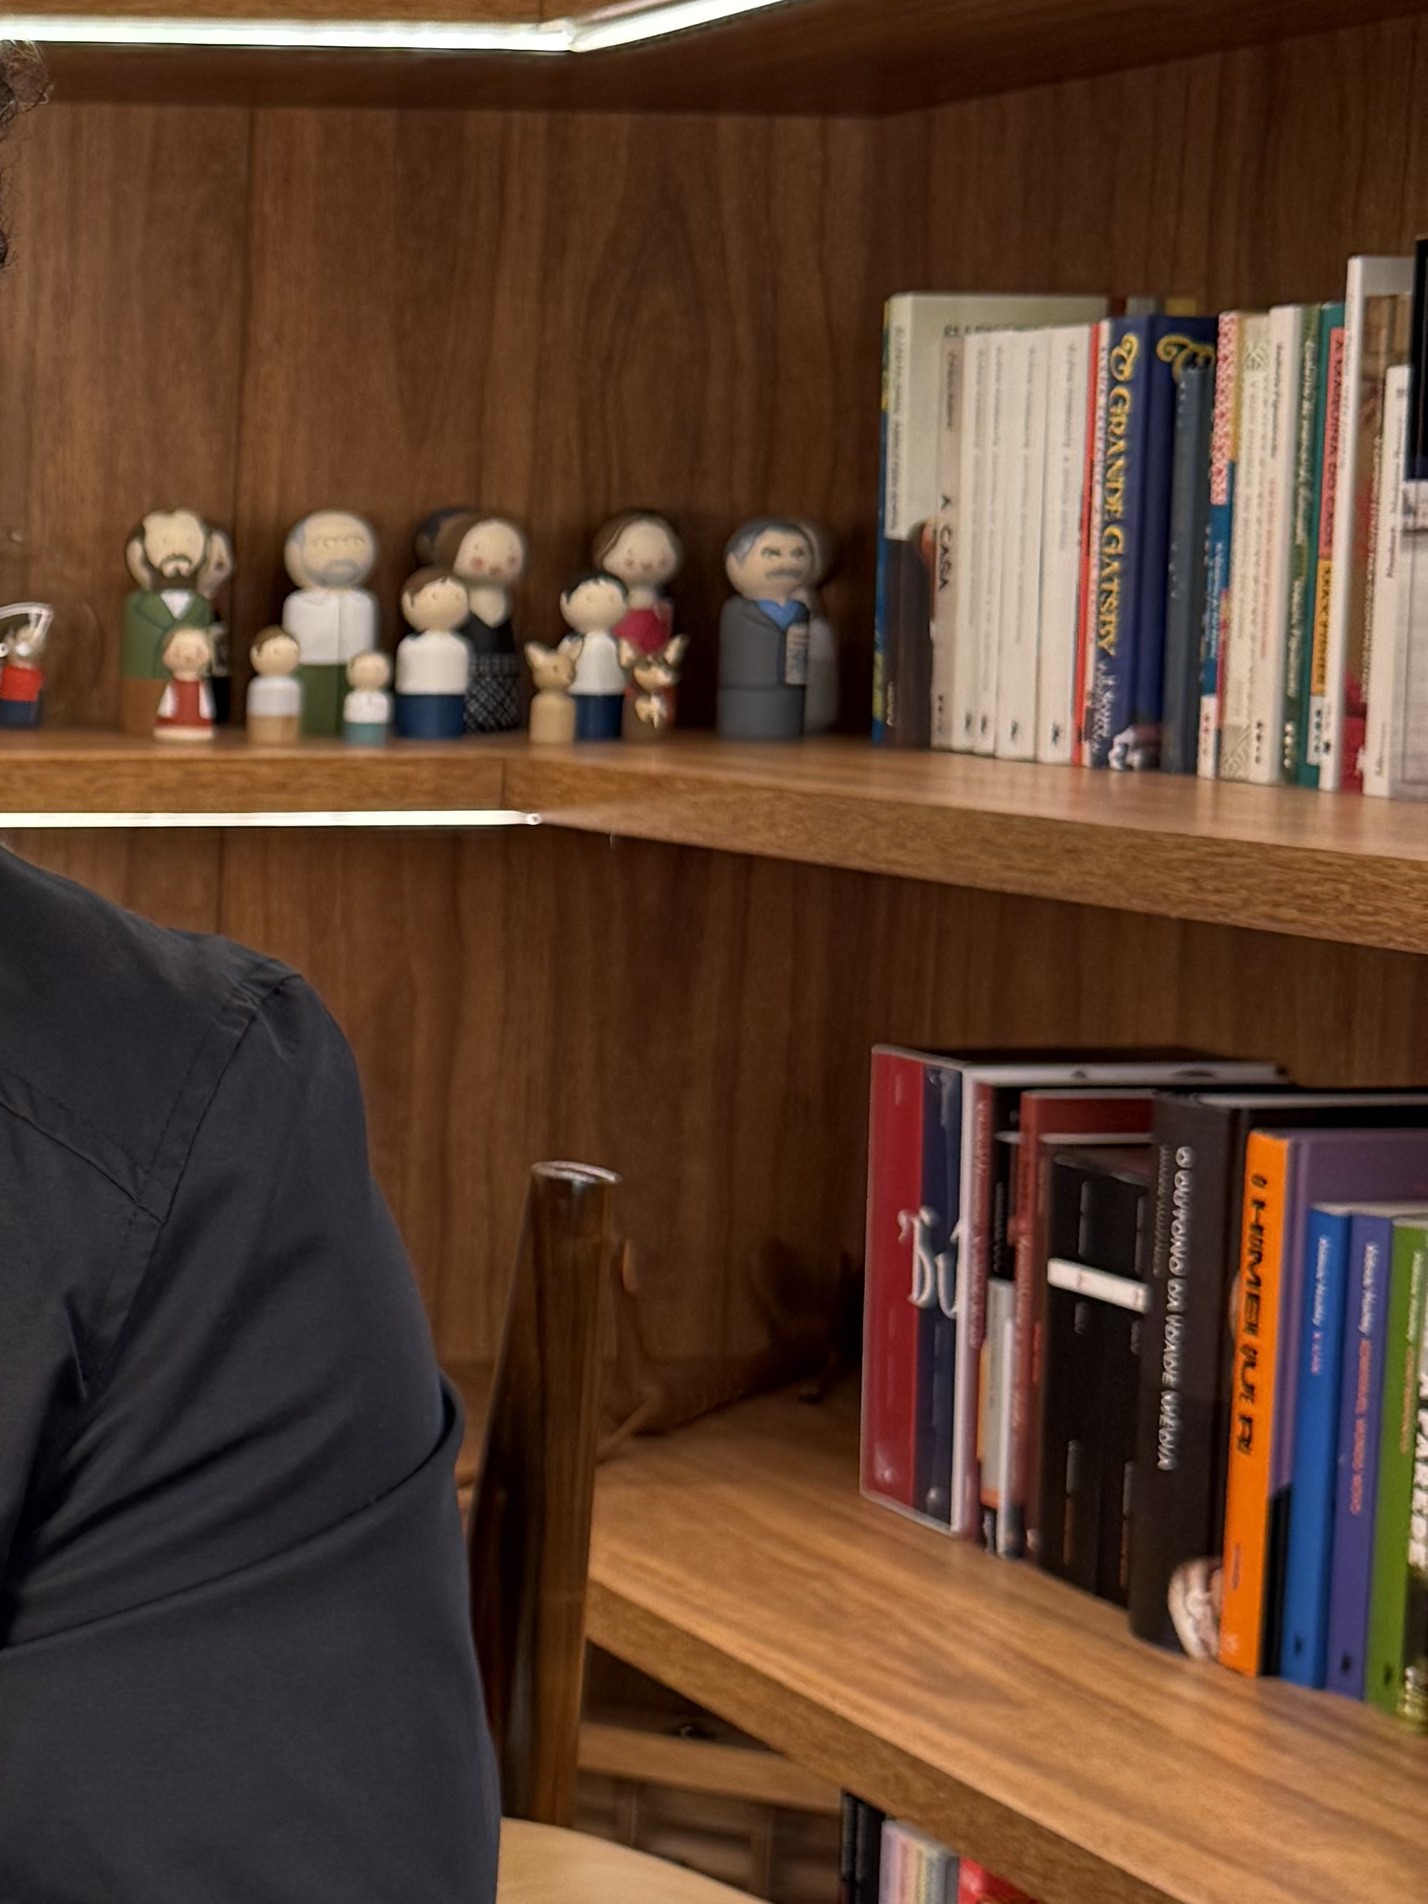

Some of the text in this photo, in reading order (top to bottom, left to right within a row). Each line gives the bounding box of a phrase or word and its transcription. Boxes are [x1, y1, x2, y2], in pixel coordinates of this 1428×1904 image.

[938, 495, 954, 591] A CASA
[1095, 385, 1133, 658] GRANDE GATSBY
[1157, 1145, 1192, 1472] O OUTONO DA IDADE MÉDIA
